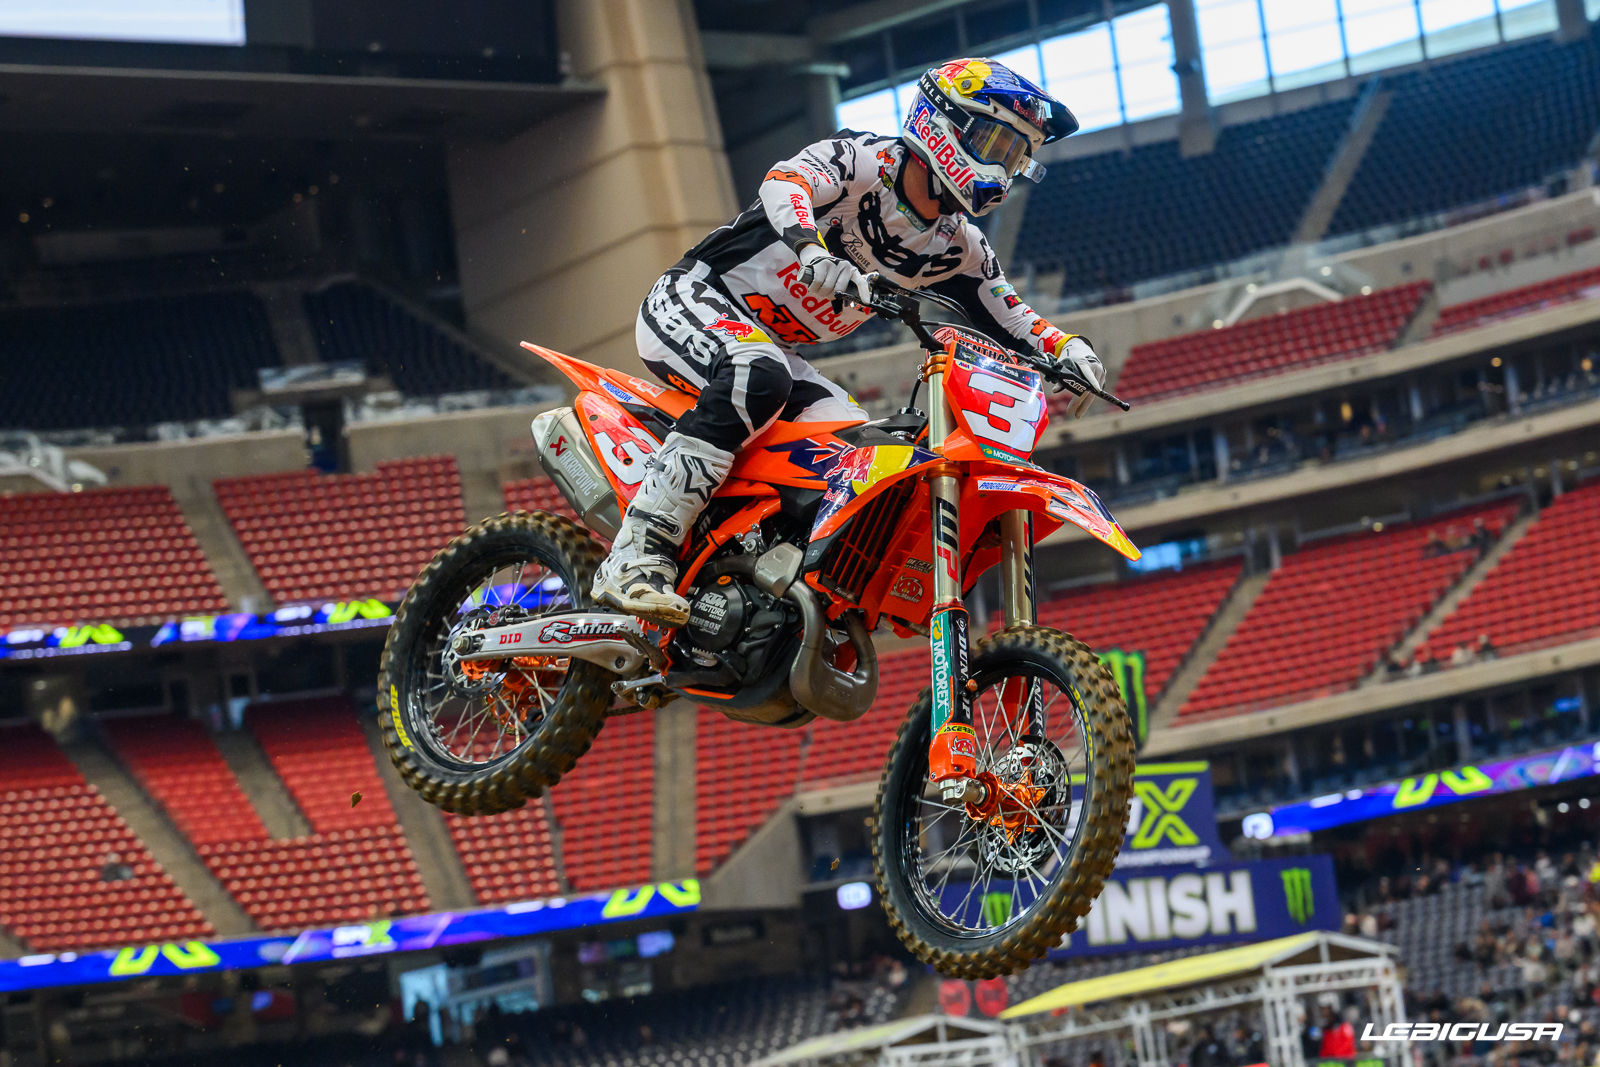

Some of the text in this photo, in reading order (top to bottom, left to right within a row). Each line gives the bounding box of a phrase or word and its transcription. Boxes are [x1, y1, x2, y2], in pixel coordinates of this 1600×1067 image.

[914, 107, 947, 152] Red
[935, 143, 976, 189] Bull
[776, 261, 863, 336] Red Bull
[602, 381, 633, 402] PROGRESSIVE
[1063, 379, 1087, 393] ARC
[961, 371, 1042, 453] 3
[594, 426, 664, 486] 3
[978, 481, 1018, 491] PROGRESSIVE
[694, 601, 727, 617] FACTORY
[701, 592, 727, 608] KTM
[499, 632, 522, 645] DID
[933, 641, 950, 710] MOTOREX
